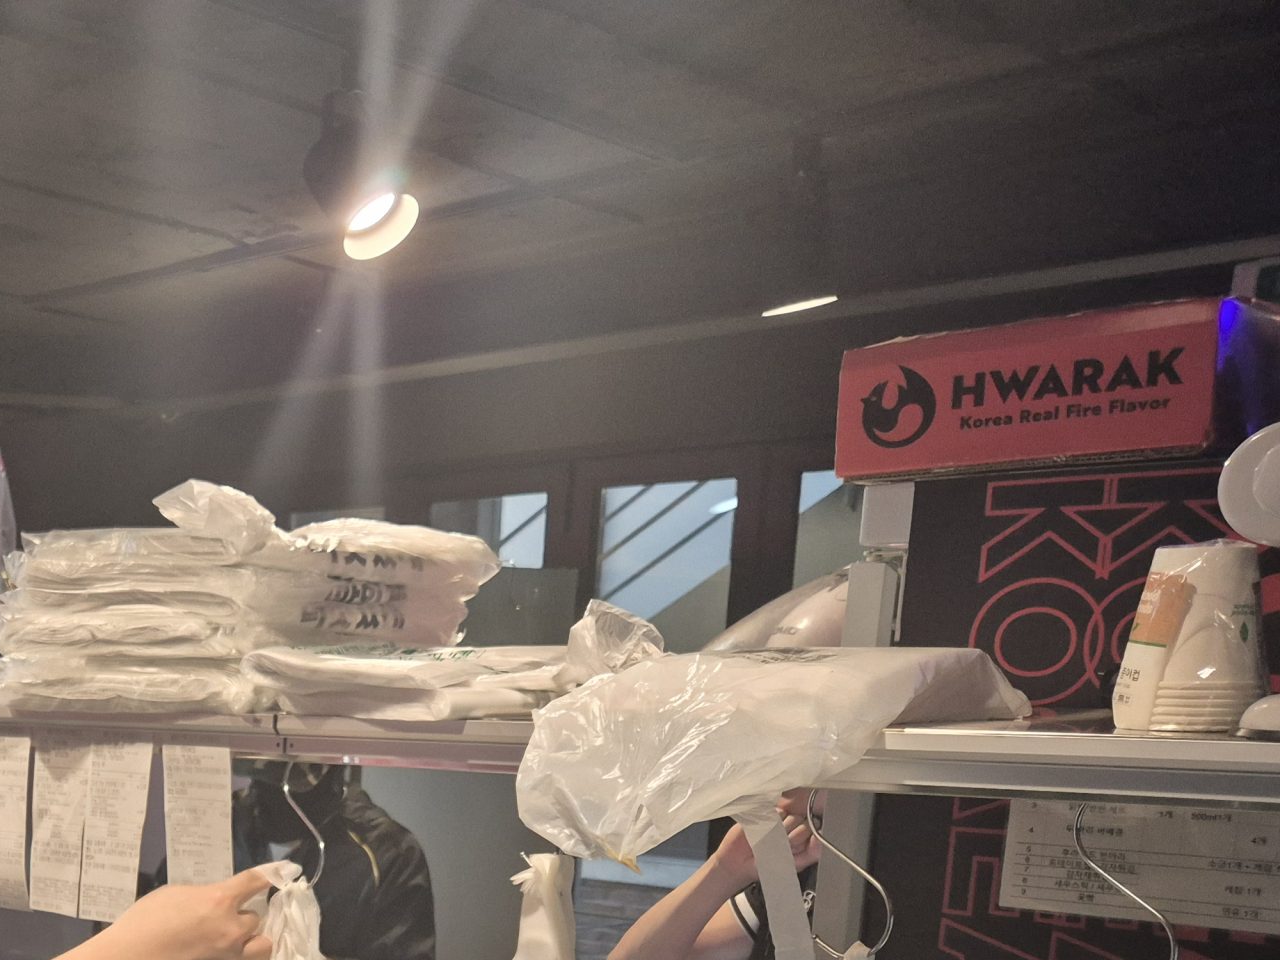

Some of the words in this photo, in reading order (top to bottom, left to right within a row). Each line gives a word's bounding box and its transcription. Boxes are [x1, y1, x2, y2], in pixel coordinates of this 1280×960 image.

[951, 347, 1185, 410] HWARAK
[959, 413, 1013, 430] Korea
[1019, 409, 1059, 424] Real
[1066, 404, 1101, 419] Fire
[1108, 397, 1171, 415] Flavor
